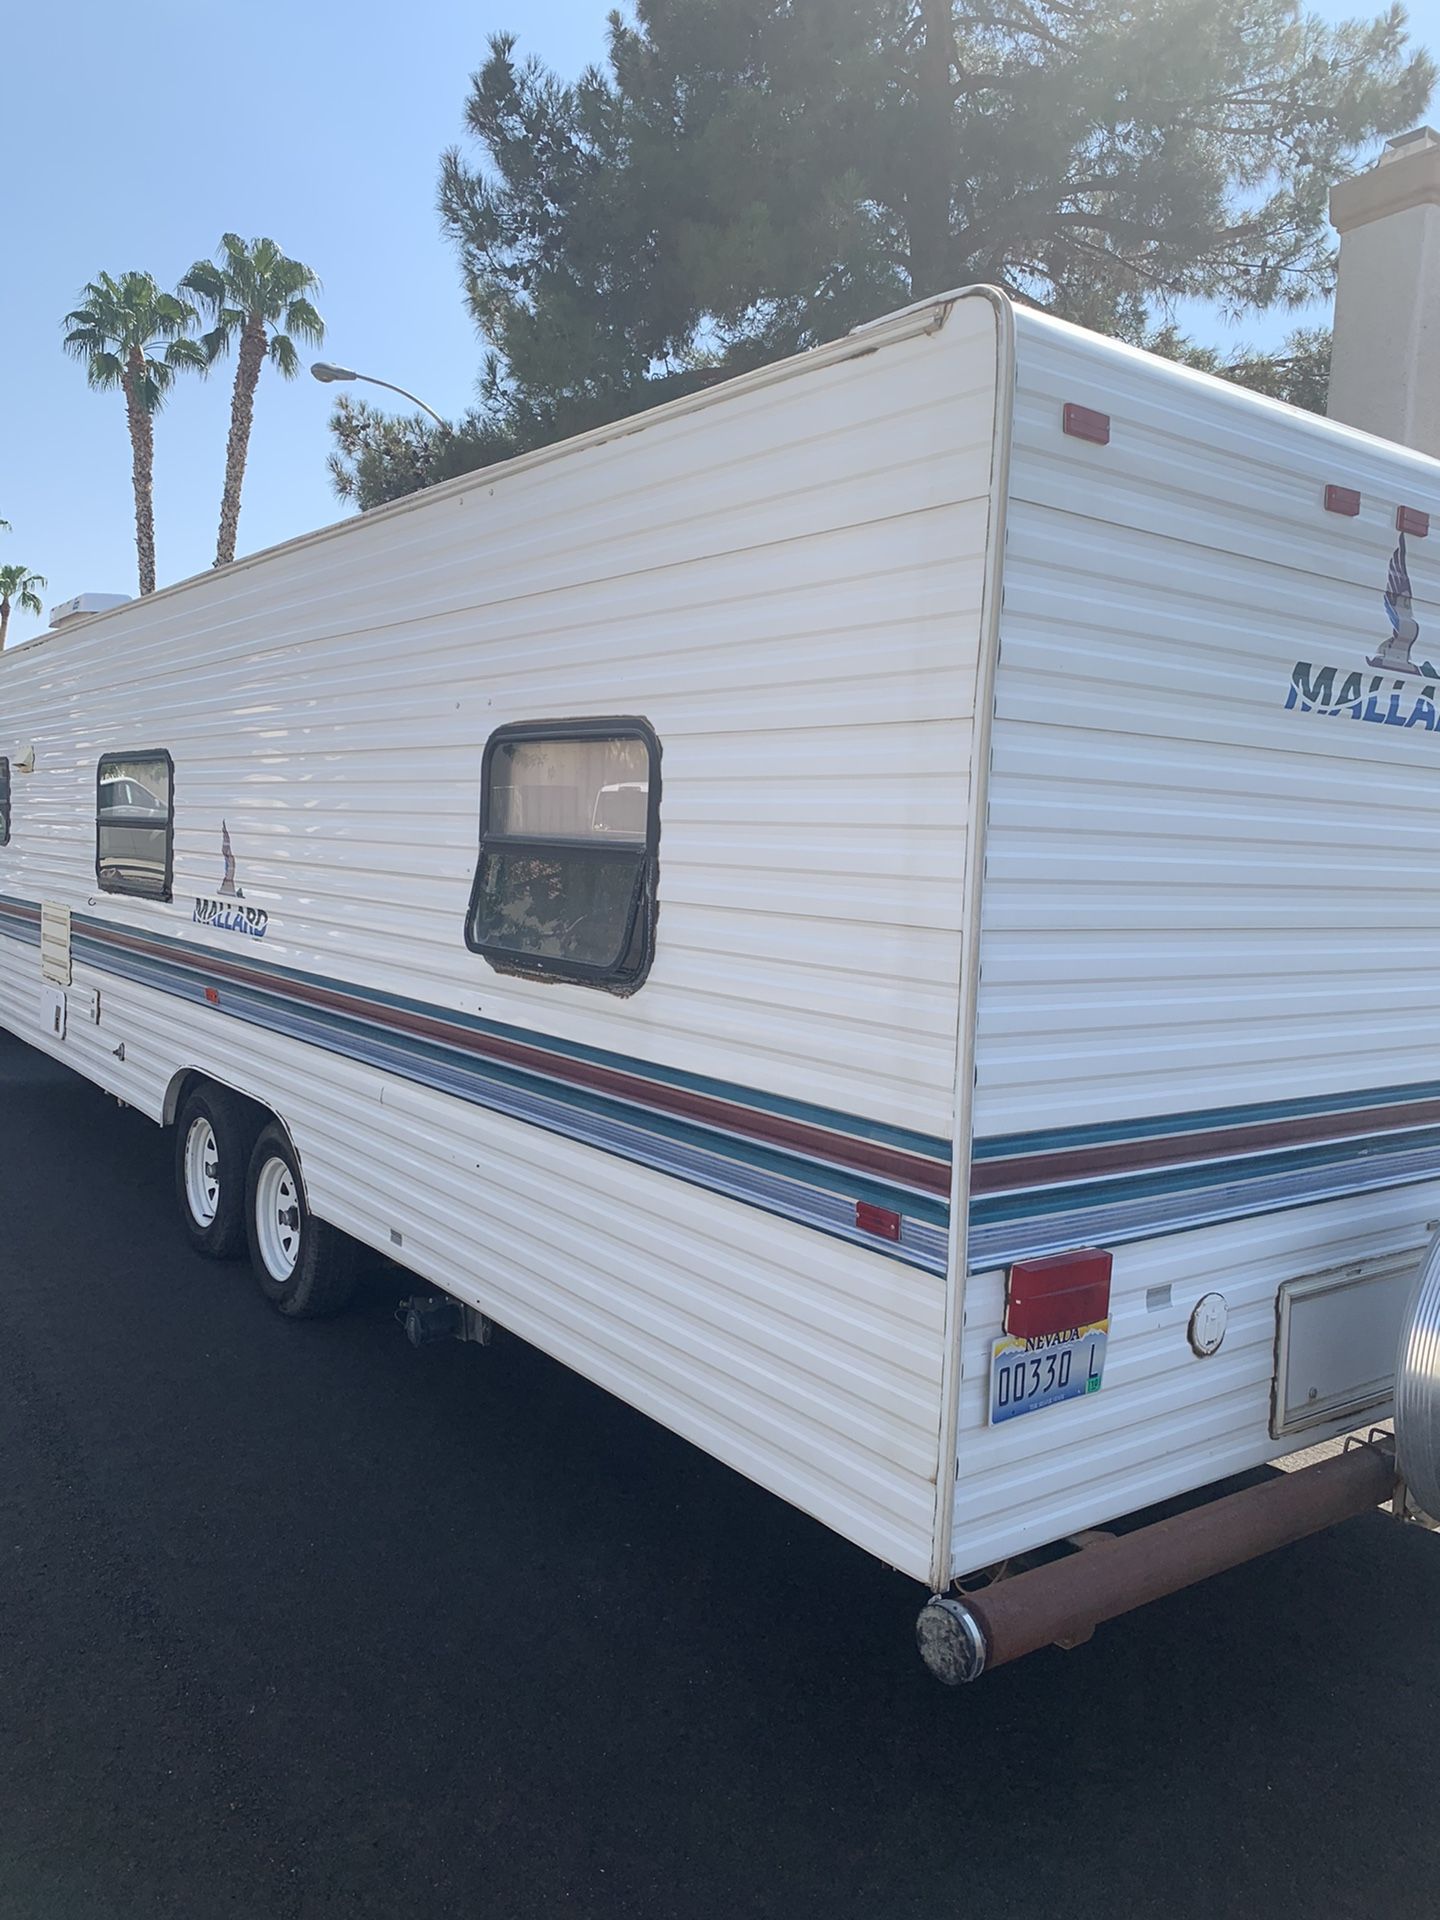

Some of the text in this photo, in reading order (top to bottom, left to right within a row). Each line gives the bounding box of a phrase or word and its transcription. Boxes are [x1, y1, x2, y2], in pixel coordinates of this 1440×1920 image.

[1284, 661, 1440, 731] MALLA
[193, 898, 268, 937] MALLARD
[1025, 1328, 1079, 1352] NEVADA
[999, 1344, 1098, 1406] 00330 L
